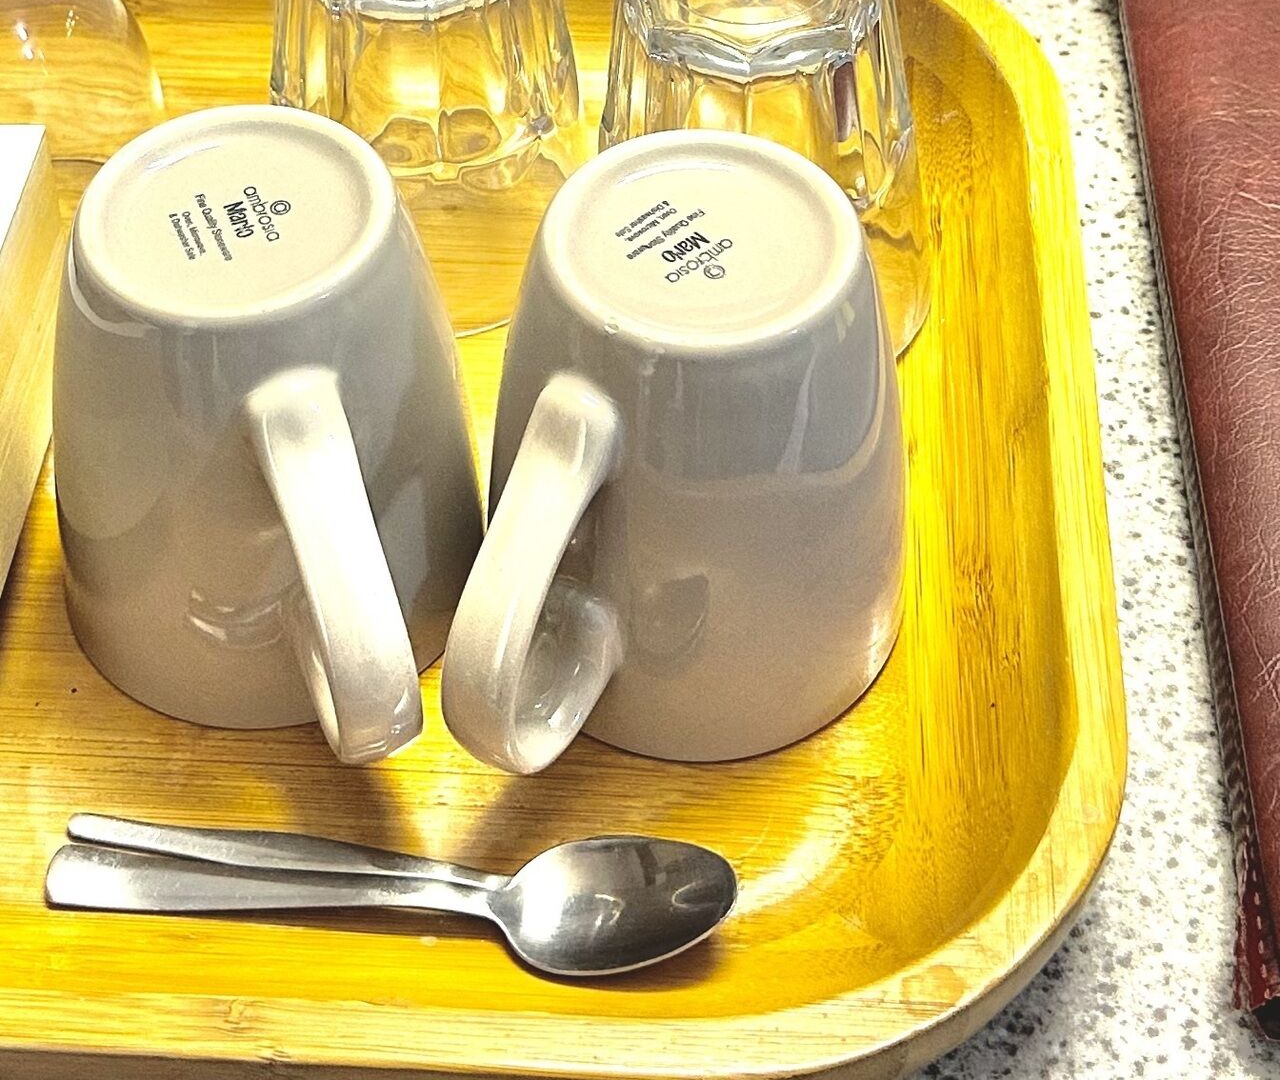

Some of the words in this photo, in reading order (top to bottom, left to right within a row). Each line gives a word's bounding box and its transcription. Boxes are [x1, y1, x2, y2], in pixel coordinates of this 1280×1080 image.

[194, 192, 207, 209] Fine
[201, 206, 218, 230] Quality
[243, 185, 281, 243] ambrosia
[662, 219, 689, 237] Quality
[687, 209, 705, 221] Fine
[664, 238, 733, 283] ambrosia
